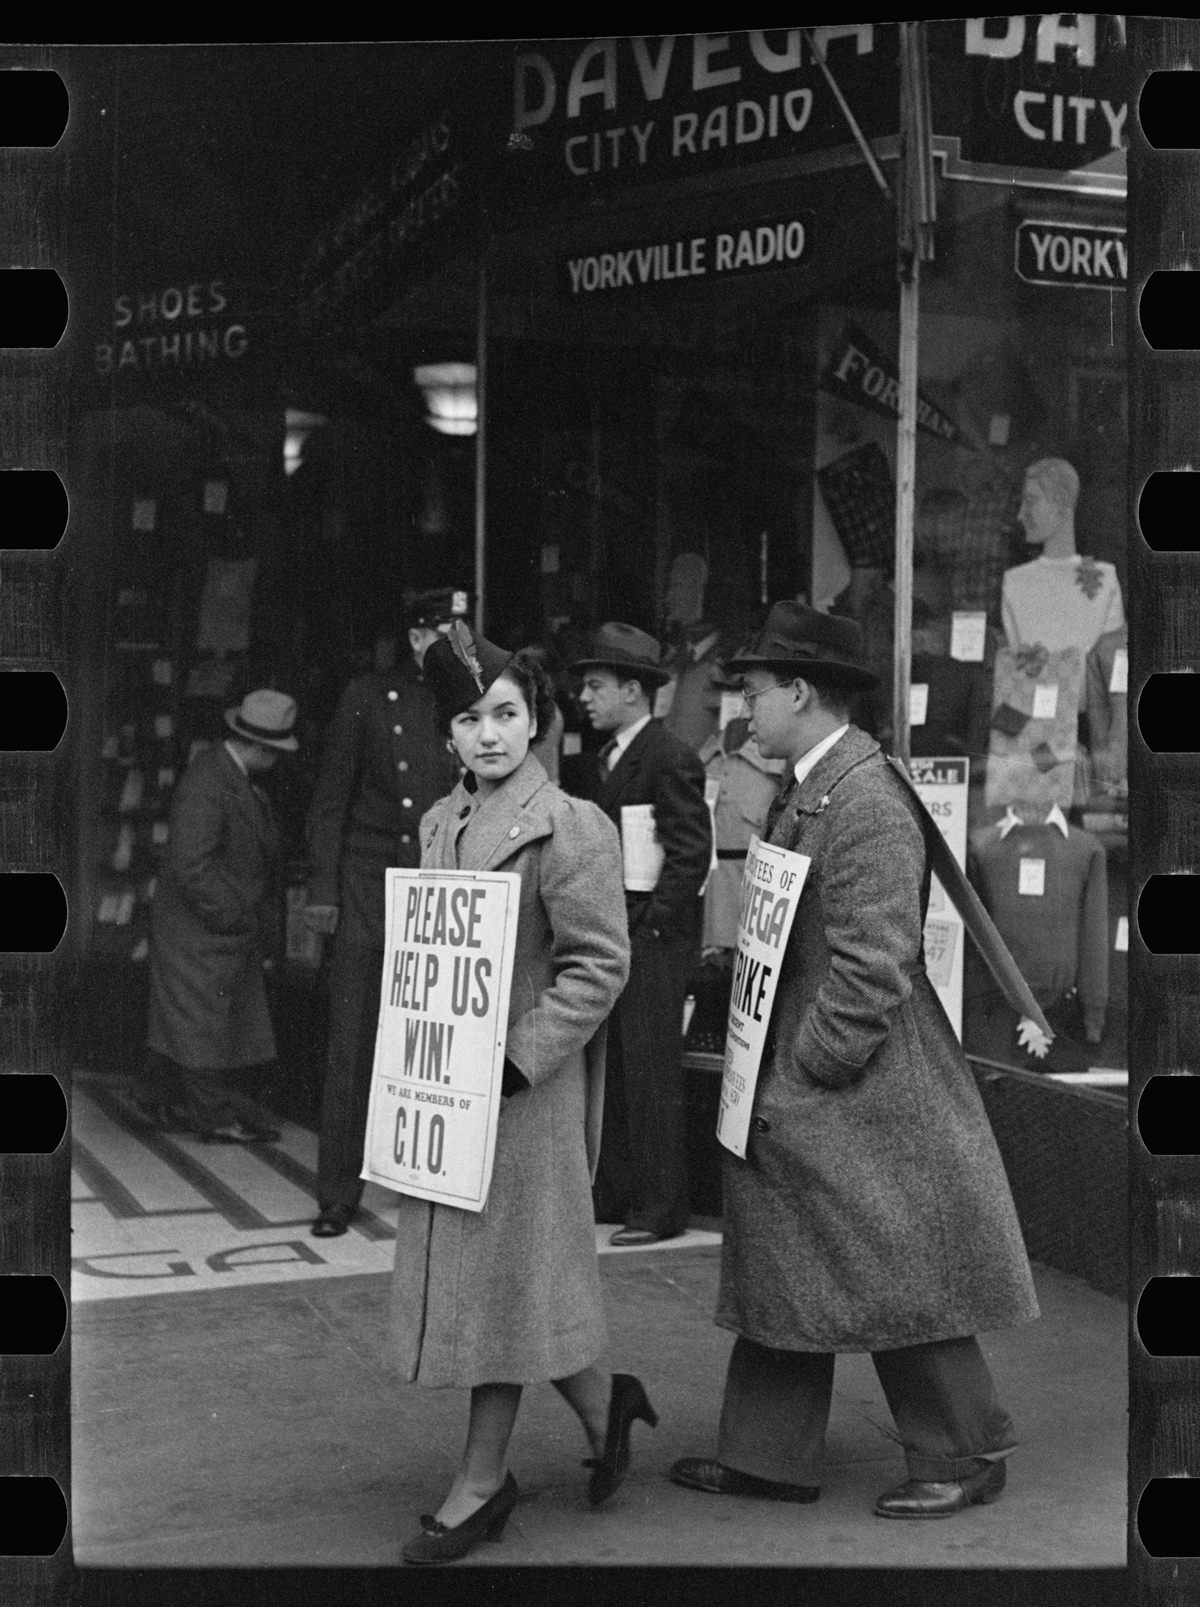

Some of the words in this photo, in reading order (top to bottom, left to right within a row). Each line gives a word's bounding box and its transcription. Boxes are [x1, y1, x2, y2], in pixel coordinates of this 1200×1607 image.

[965, 14, 1126, 67] DA
[565, 121, 655, 176] CITY
[672, 88, 813, 157] RADIO
[1013, 90, 1128, 148] CITY
[567, 238, 706, 293] YORKVILLE
[715, 221, 805, 271] RADIO
[114, 281, 228, 327] SHOES
[95, 324, 249, 374] BATHING
[910, 768, 959, 783] SALE
[780, 870, 797, 891] OF
[404, 886, 486, 948] PLEASE
[390, 950, 439, 1012] HELP
[451, 956, 492, 1018] US
[403, 1018, 454, 1085] WIN!
[387, 1084, 397, 1096] WE
[399, 1088, 412, 1099] ARE
[415, 1091, 455, 1108] MEMBERS
[459, 1099, 472, 1110] OF
